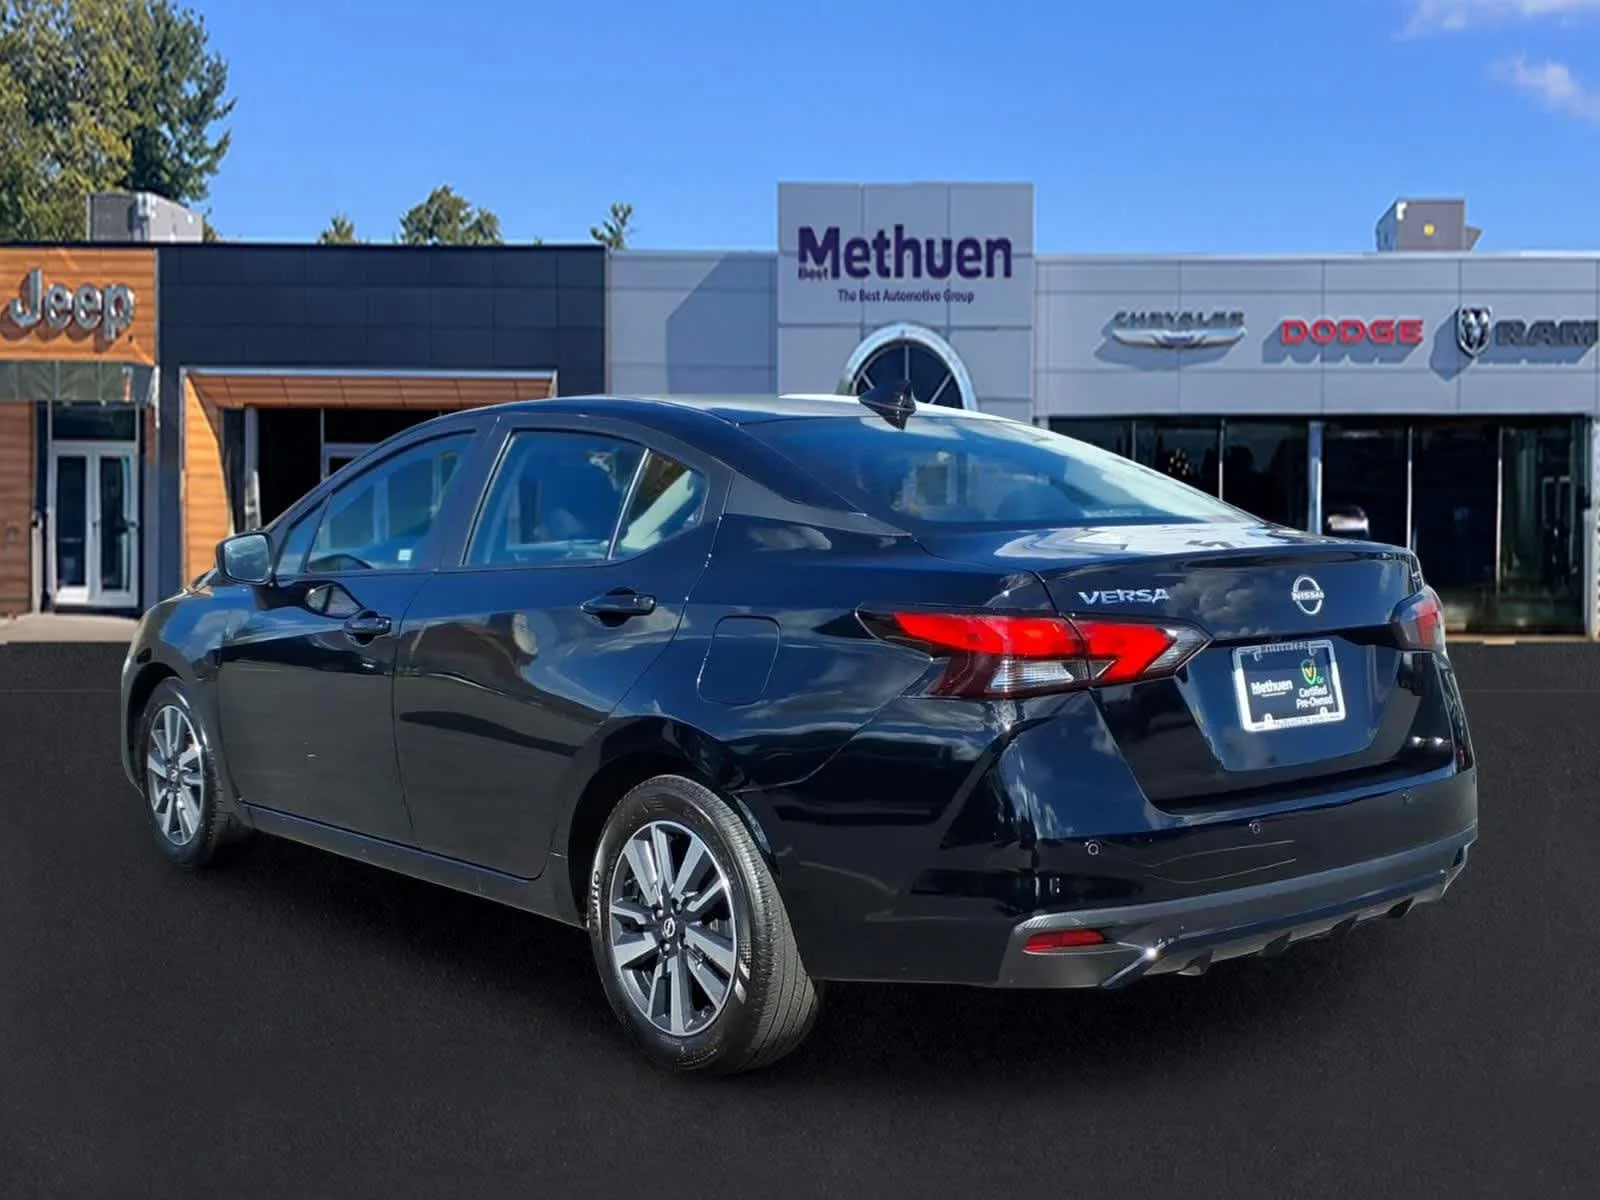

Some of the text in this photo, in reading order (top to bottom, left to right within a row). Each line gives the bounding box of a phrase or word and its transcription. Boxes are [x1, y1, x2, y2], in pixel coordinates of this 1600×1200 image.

[798, 224, 1012, 279] Methuen
[798, 267, 829, 280] Best
[9, 267, 136, 341] Jeep
[838, 289, 975, 304] The Best Automotive Group
[1114, 311, 1245, 327] CHRYSLER
[1281, 320, 1424, 345] DODGE
[1495, 319, 1599, 347] RAM
[1078, 588, 1171, 605] VERSA
[1291, 589, 1325, 602] NISSAN
[1250, 679, 1293, 696] Methuen
[1298, 684, 1328, 698] Certified
